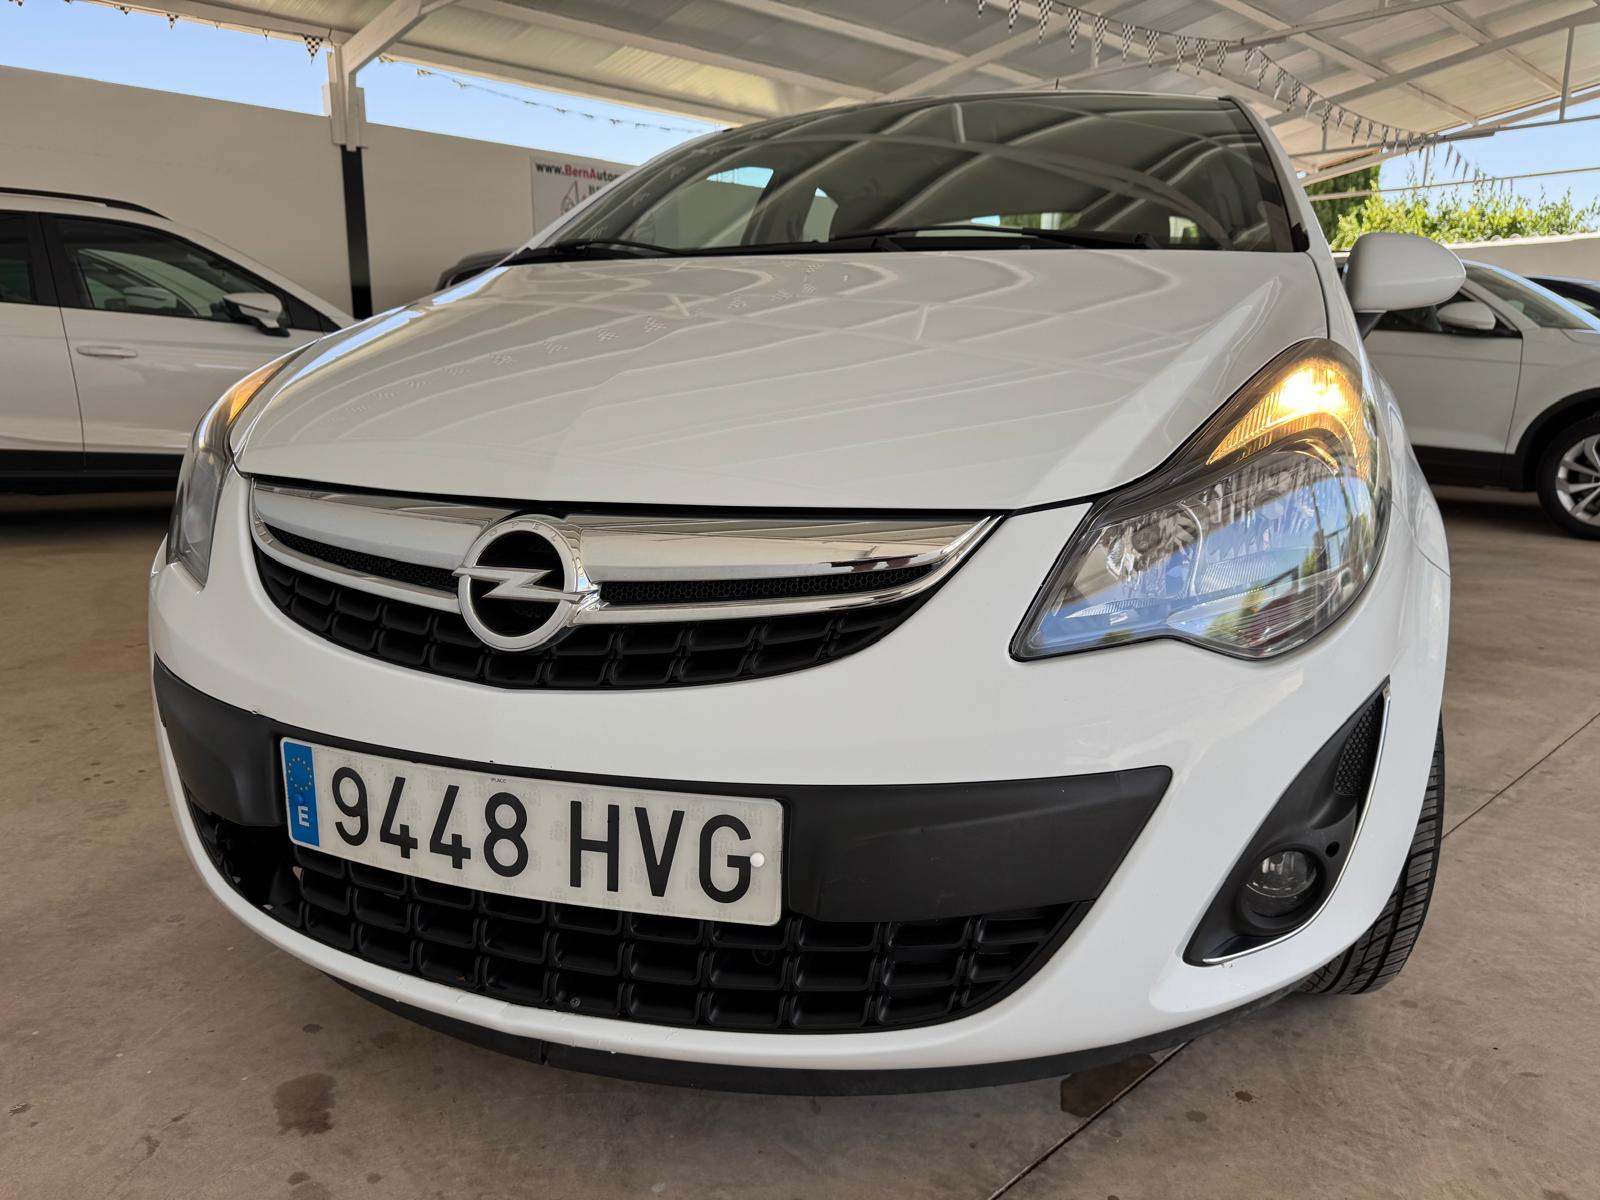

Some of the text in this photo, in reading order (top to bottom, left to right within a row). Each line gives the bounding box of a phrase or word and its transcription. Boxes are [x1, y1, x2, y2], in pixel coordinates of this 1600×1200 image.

[489, 520, 558, 541] OPEL
[297, 805, 310, 827] E
[331, 766, 752, 904] 9448 HVG
